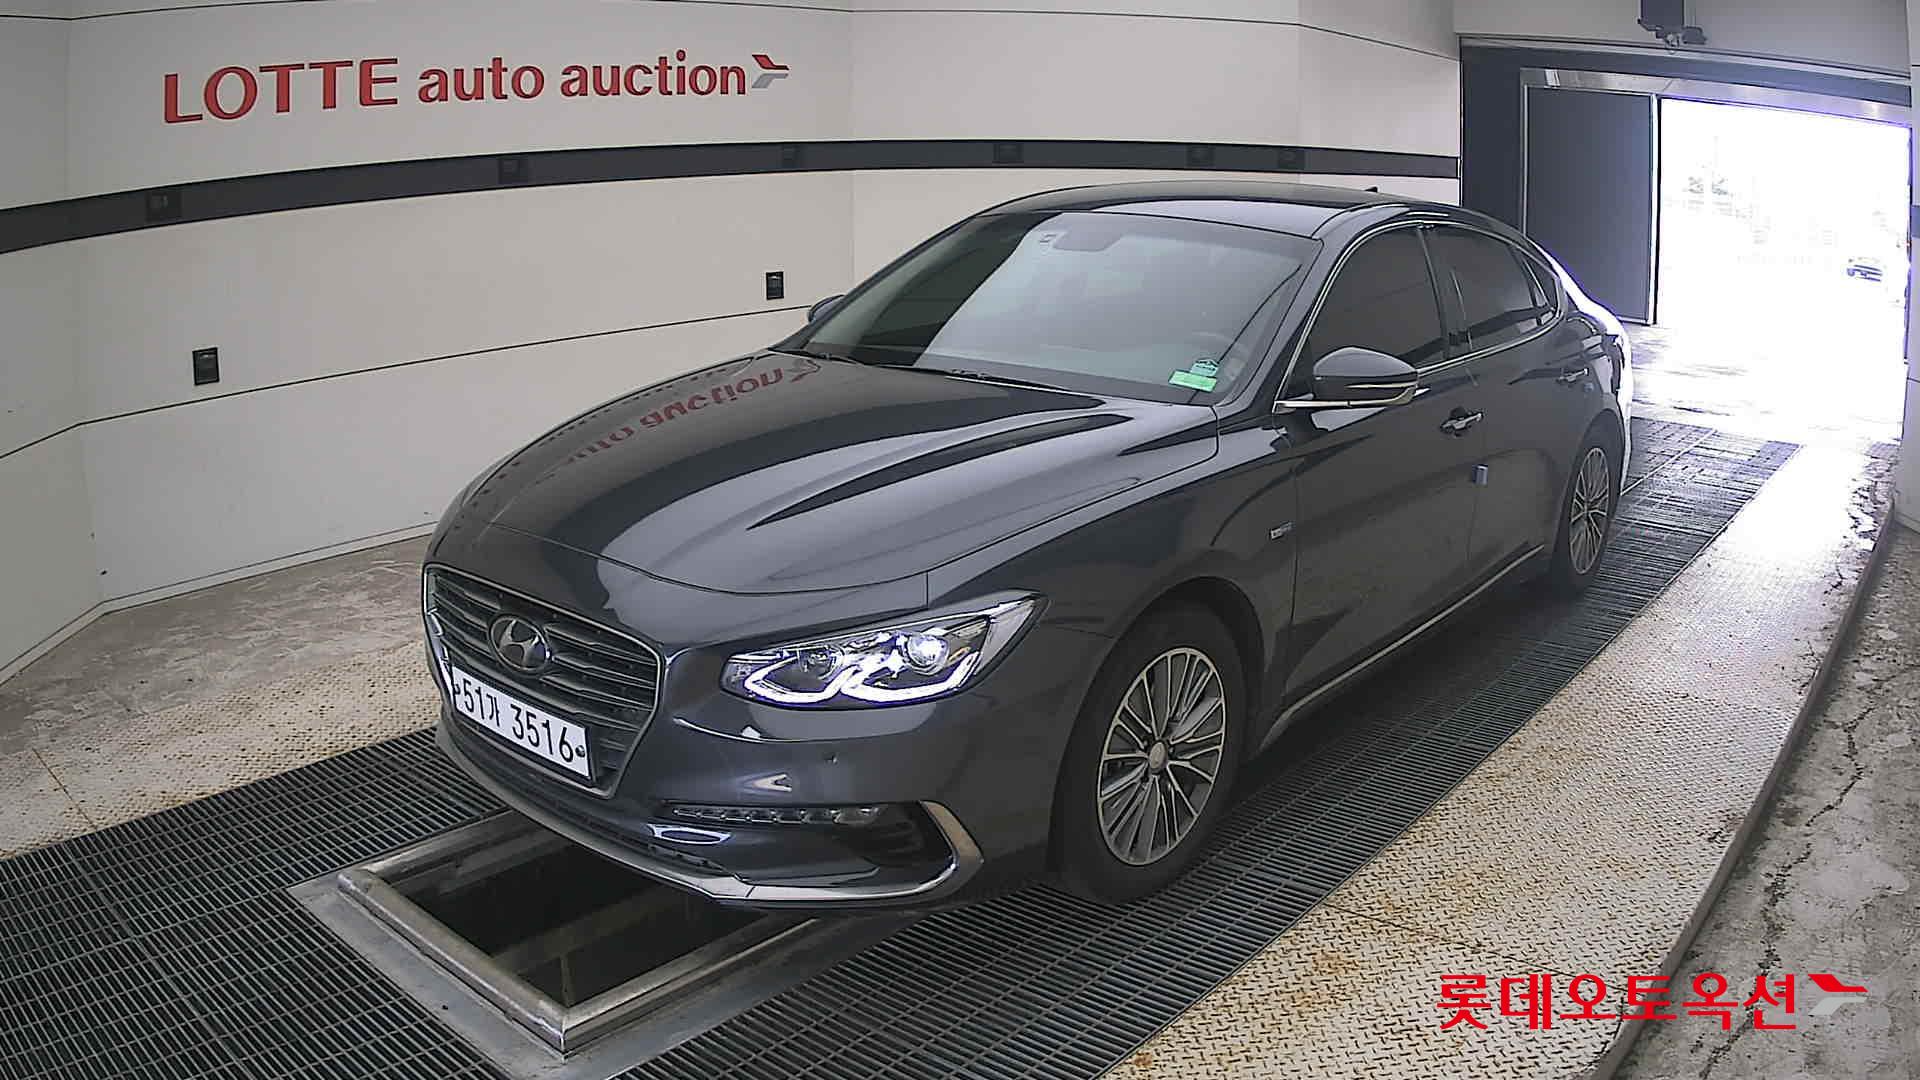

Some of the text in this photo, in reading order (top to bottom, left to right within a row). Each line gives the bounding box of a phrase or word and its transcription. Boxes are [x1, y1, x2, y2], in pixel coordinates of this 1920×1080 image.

[164, 50, 747, 124] LOTTE auto auction
[462, 677, 575, 764] 51가 3516
